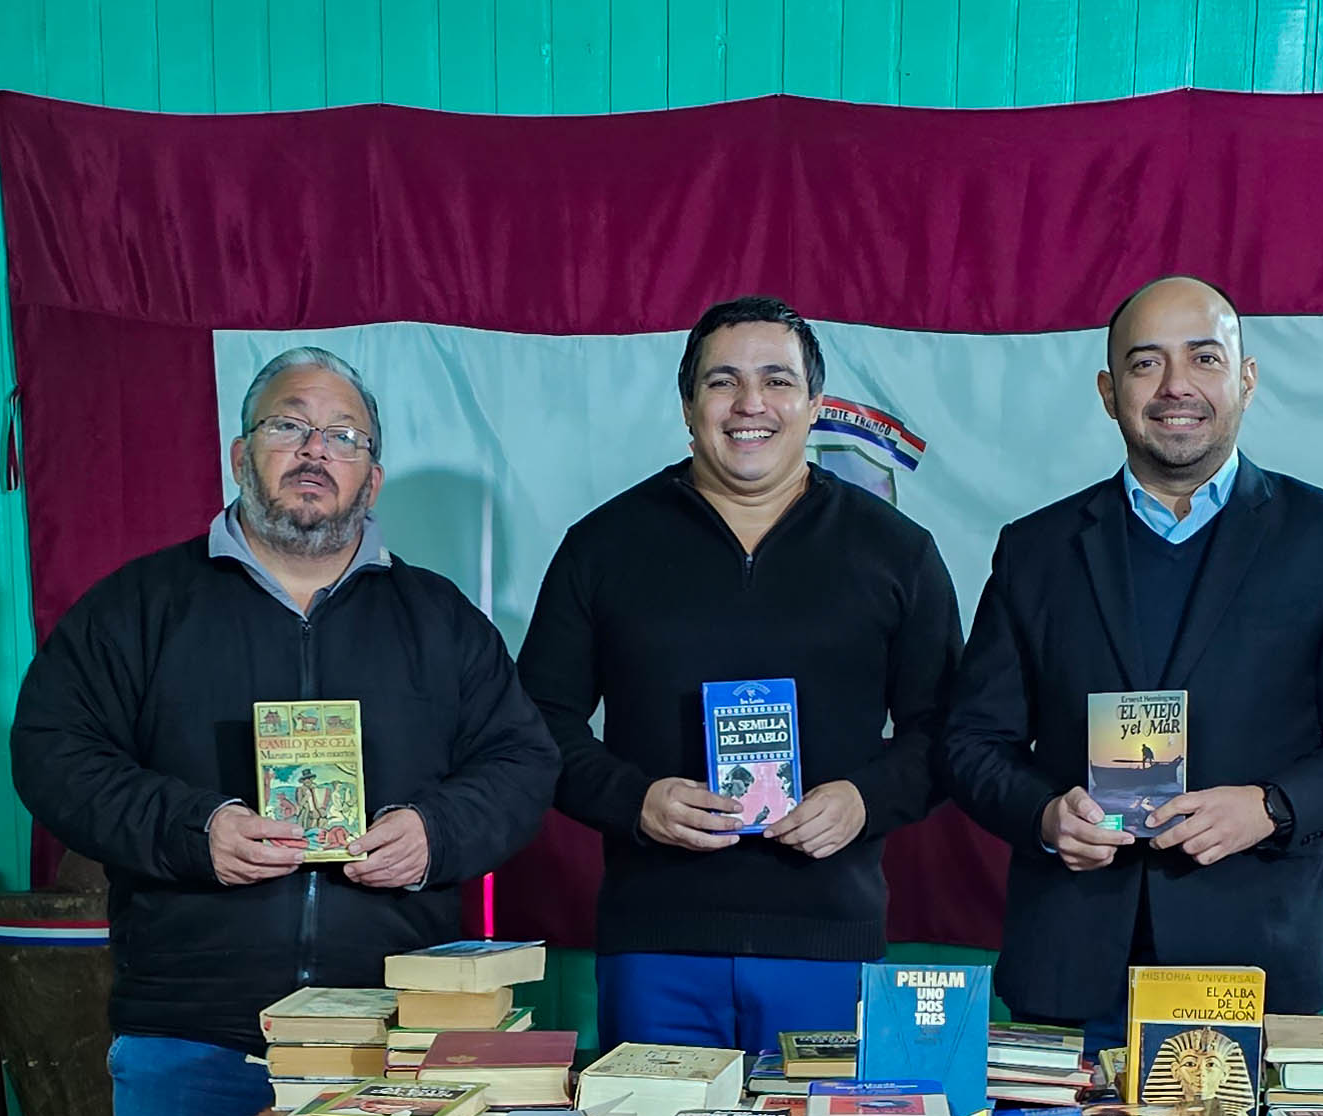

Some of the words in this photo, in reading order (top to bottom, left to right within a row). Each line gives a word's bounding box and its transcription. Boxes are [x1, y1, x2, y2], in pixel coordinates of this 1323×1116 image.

[854, 415, 892, 436] FRANCO
[1118, 704, 1138, 720] EL
[1141, 703, 1181, 721] VIEJO
[719, 721, 737, 732] LA
[738, 718, 788, 731] SEMILLA
[1121, 724, 1129, 740] y
[1130, 720, 1141, 735] el
[259, 739, 302, 749] CAMILO
[329, 738, 356, 747] CELA
[720, 734, 744, 746] DEL
[745, 731, 789, 744] DIABLO
[897, 971, 965, 988] PELHAM
[1141, 971, 1191, 981] HISTORIA
[1197, 973, 1257, 984] UNIVERSAL
[917, 988, 945, 1000] UNO
[1206, 987, 1219, 998] EL
[1223, 988, 1256, 999] ALBA
[917, 1000, 944, 1012] DOS
[1218, 999, 1232, 1009] DE
[1238, 1000, 1255, 1010] LA
[914, 1012, 946, 1026] TRES
[1172, 1008, 1255, 1021] CIVILIZACION
